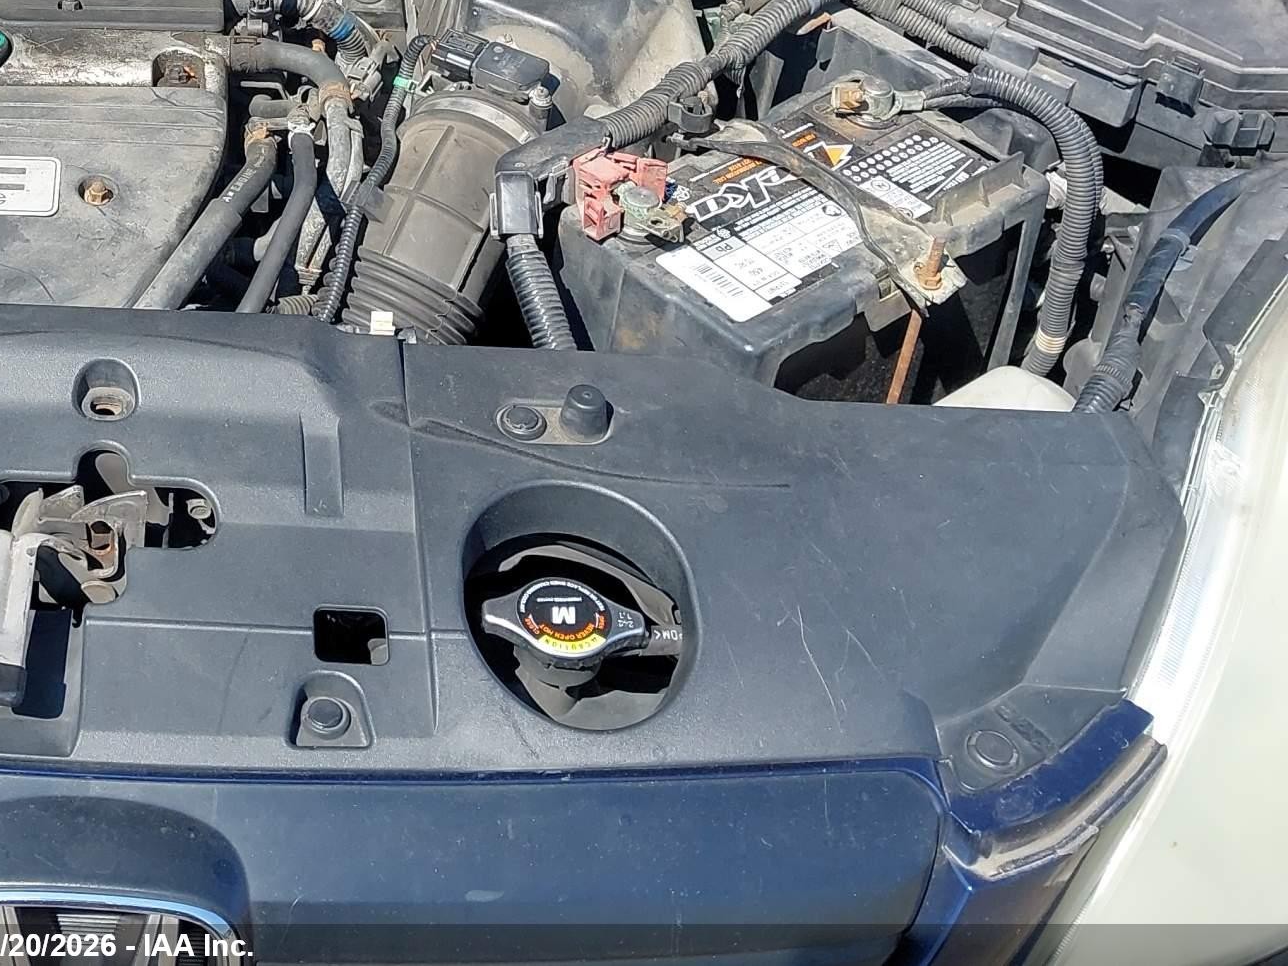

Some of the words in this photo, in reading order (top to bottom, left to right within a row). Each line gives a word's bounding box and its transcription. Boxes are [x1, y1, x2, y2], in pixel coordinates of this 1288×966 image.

[551, 606, 576, 625] M
[538, 623, 554, 636] HOT
[554, 631, 575, 641] OPEN
